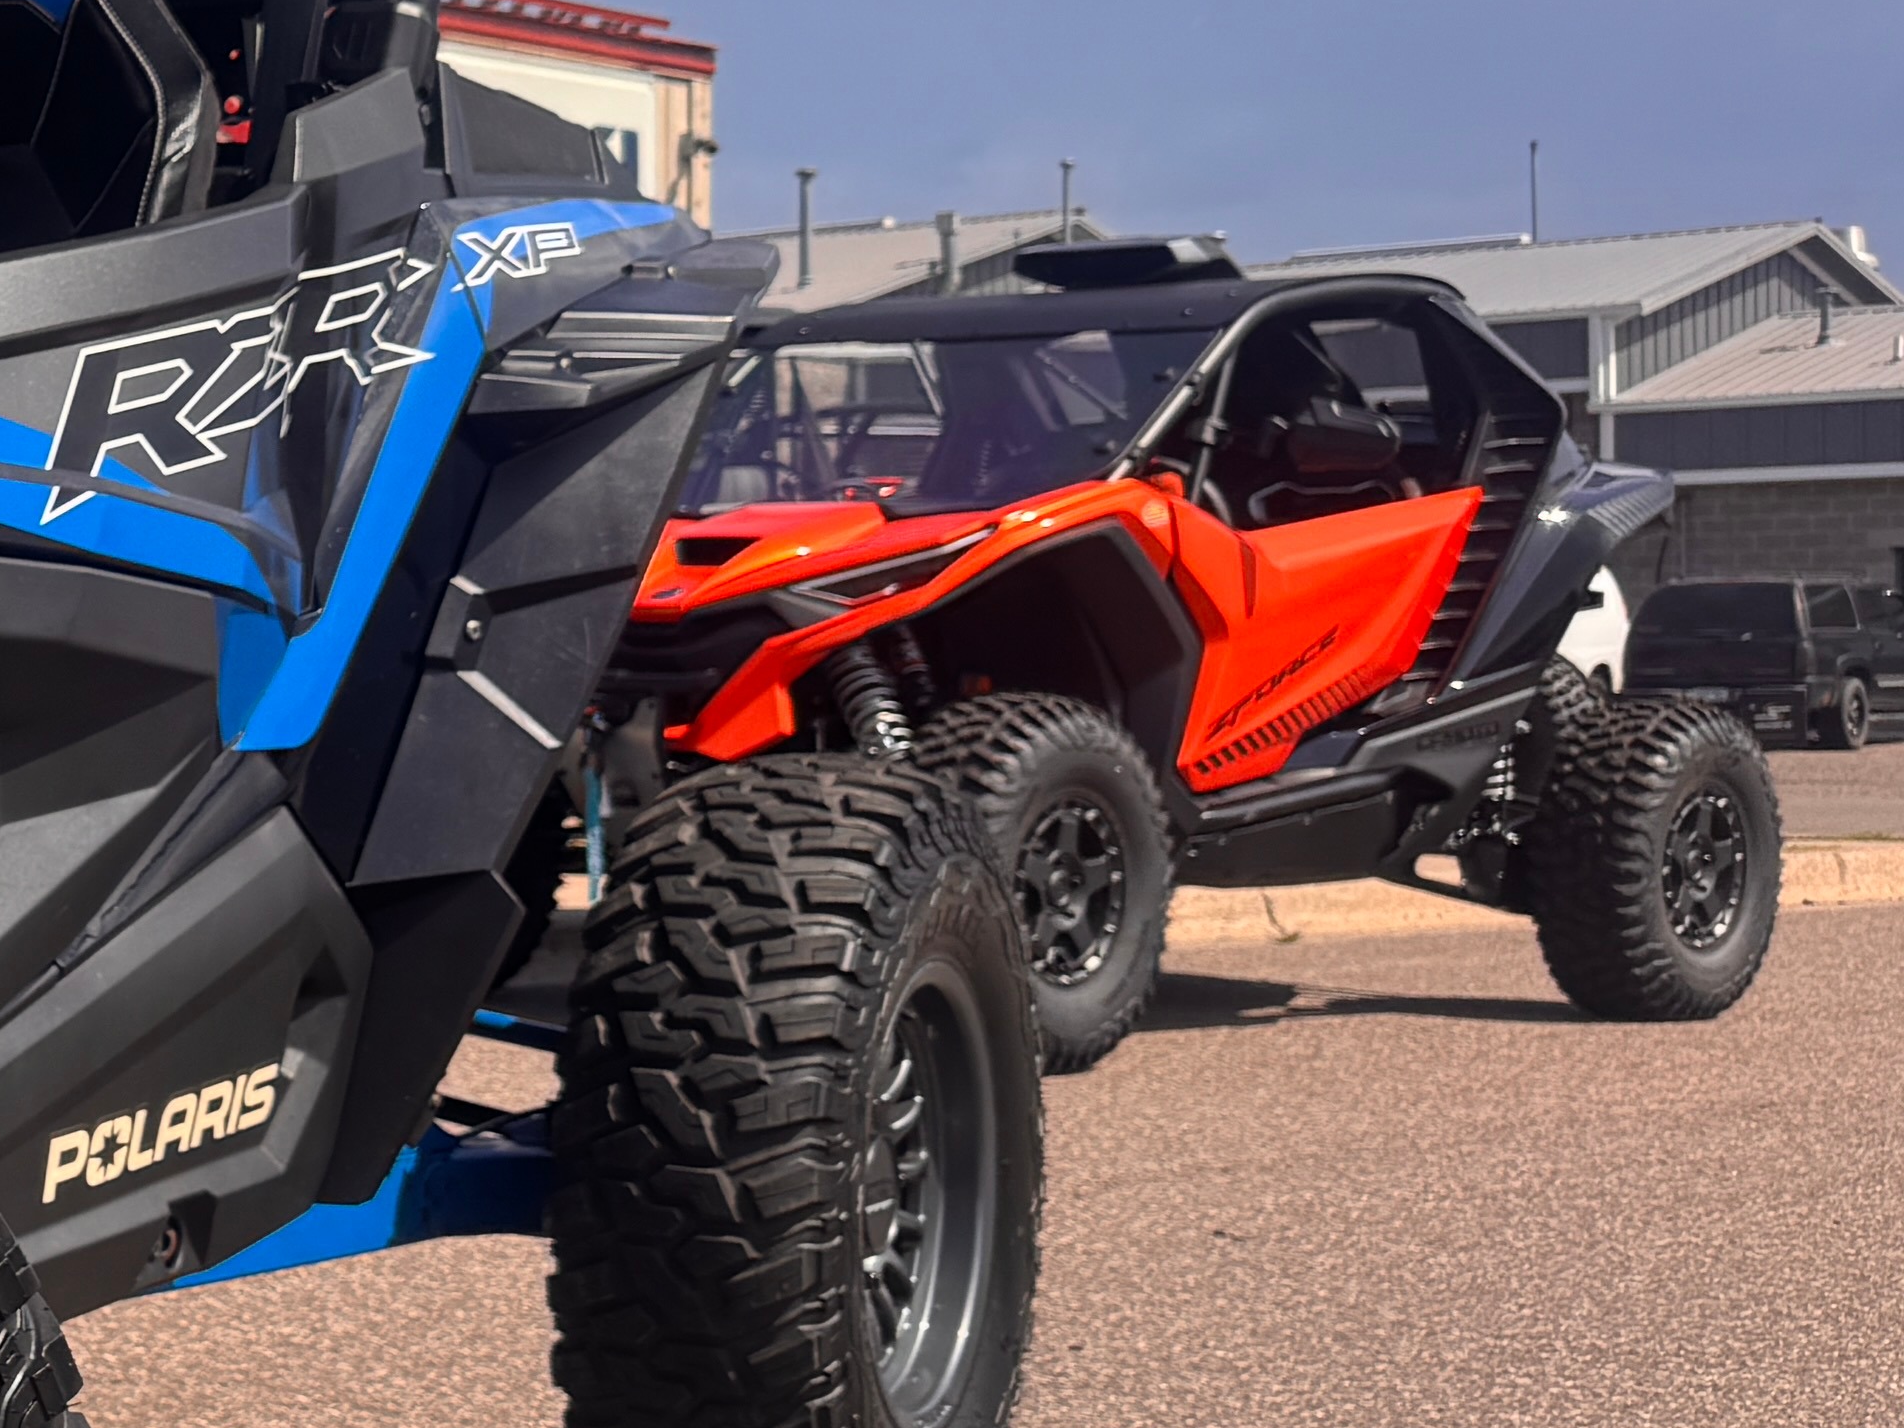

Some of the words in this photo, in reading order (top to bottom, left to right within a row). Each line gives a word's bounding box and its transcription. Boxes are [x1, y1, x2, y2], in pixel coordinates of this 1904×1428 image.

[451, 221, 582, 292] XP
[39, 246, 436, 526] RZR
[42, 1061, 280, 1204] POLARIS
